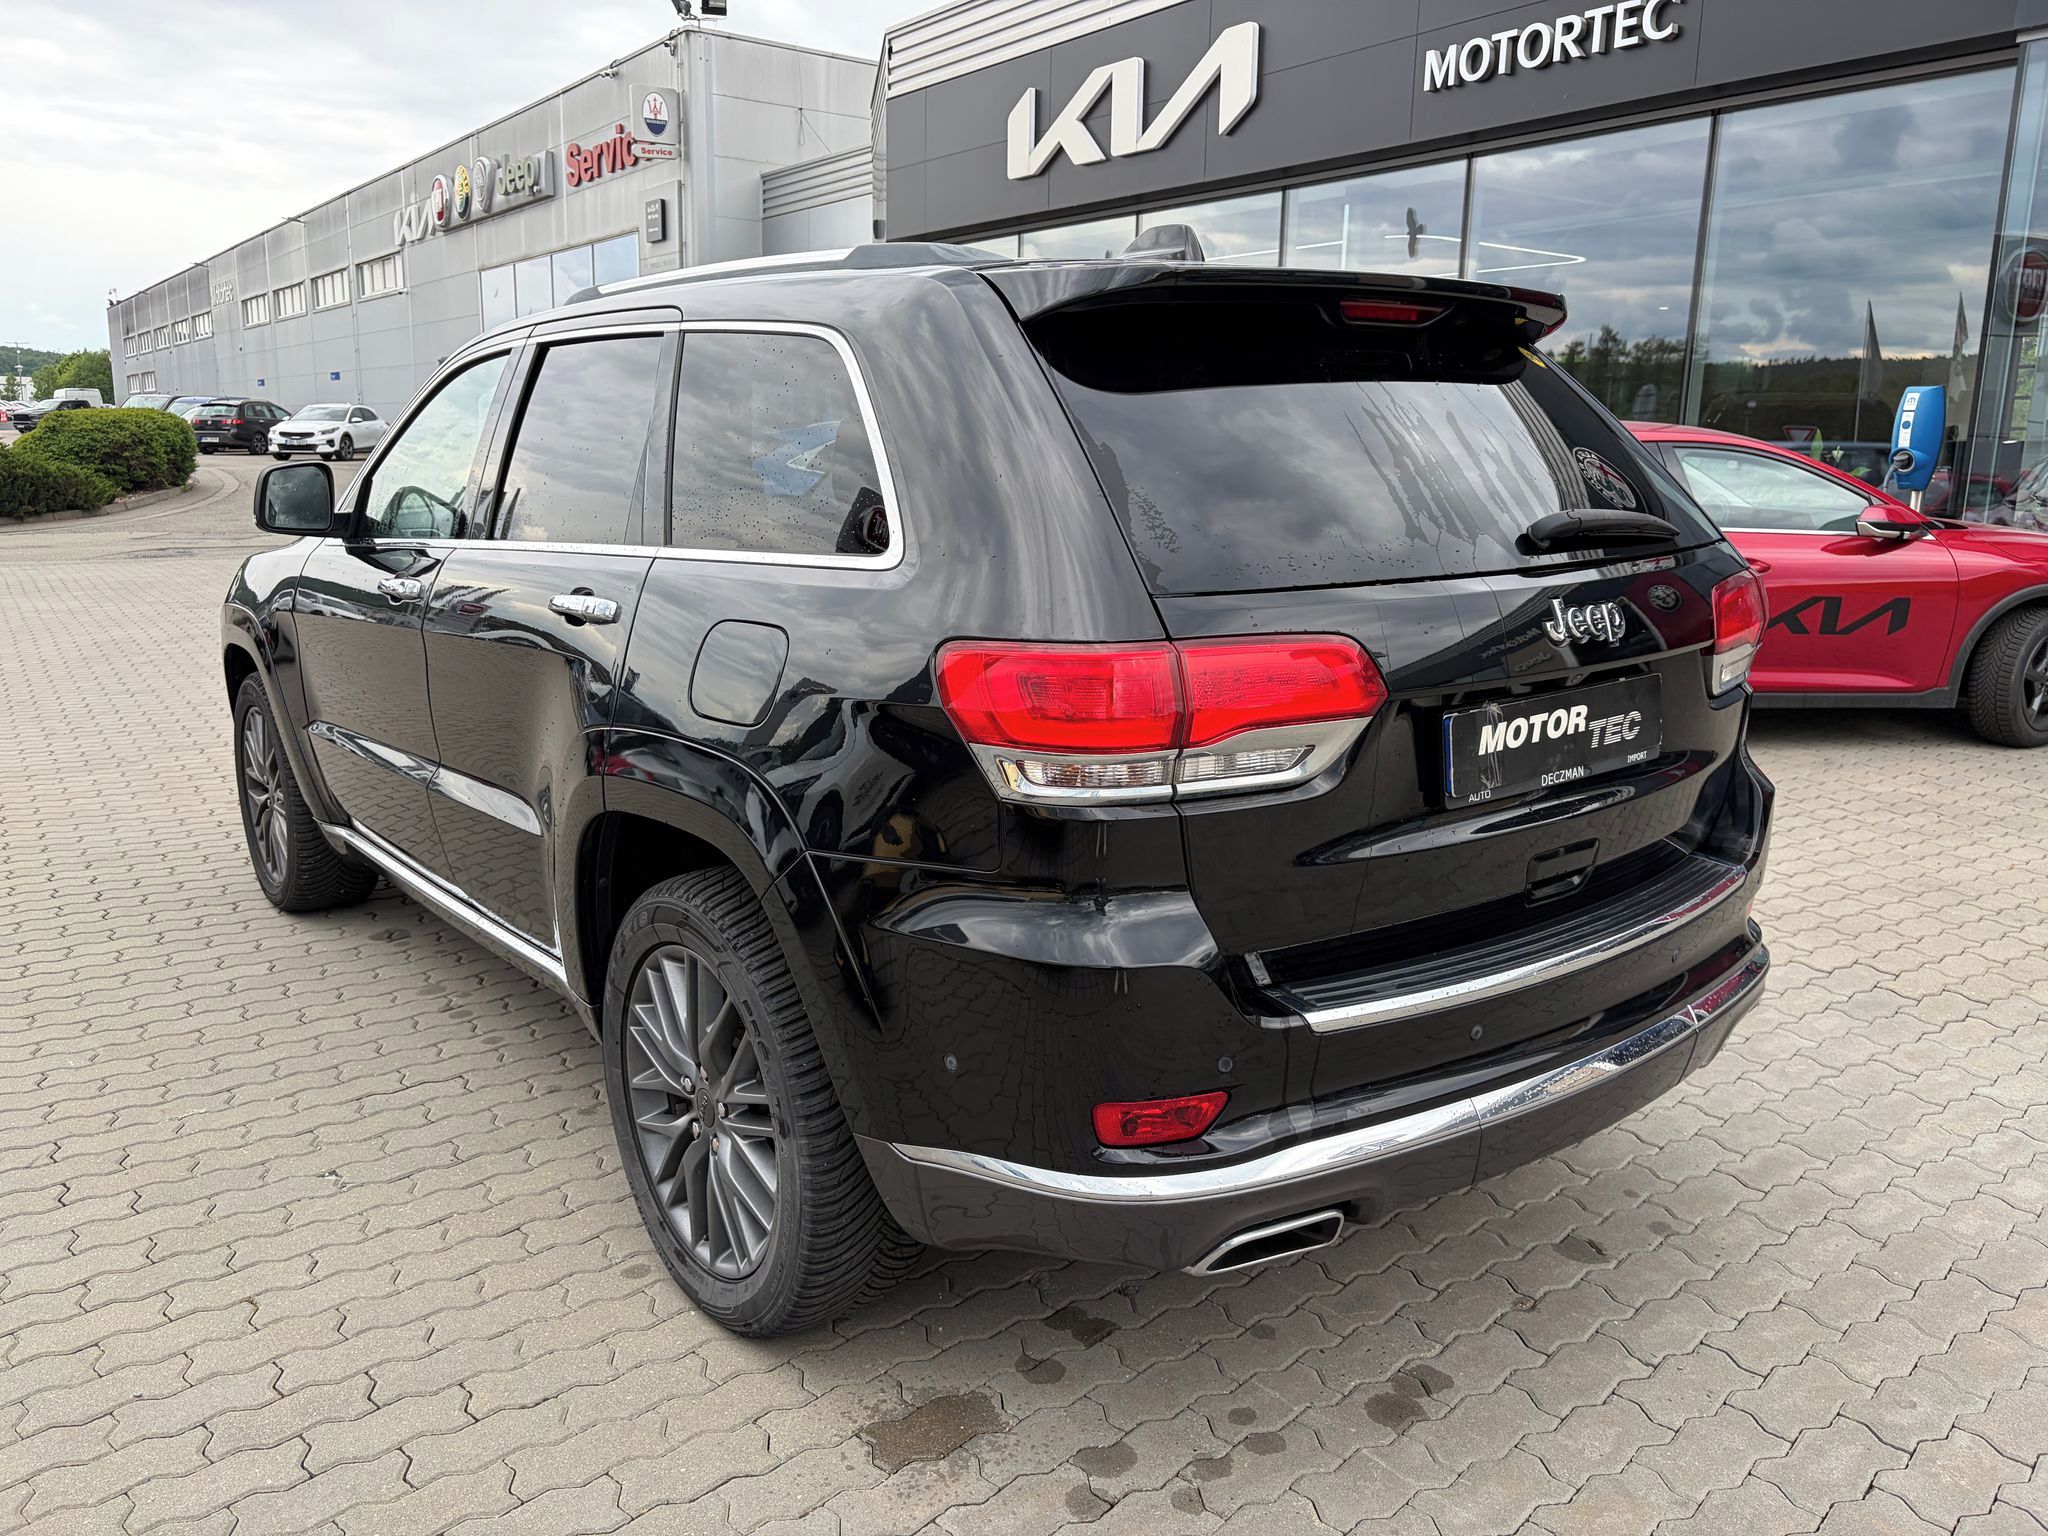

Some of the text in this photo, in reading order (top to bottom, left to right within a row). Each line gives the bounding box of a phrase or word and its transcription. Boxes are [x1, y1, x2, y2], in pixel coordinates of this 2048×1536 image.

[1422, 0, 1681, 92] MOTORTEC
[1007, 22, 1260, 180] KIA
[497, 153, 536, 197] Jeep
[566, 124, 654, 188] Servic
[640, 147, 673, 156] Service
[1542, 596, 1626, 647] Jeep
[1478, 704, 1641, 756] MOTOR TEC
[1468, 750, 1648, 803] AUTO DECZMAN IMPORT
